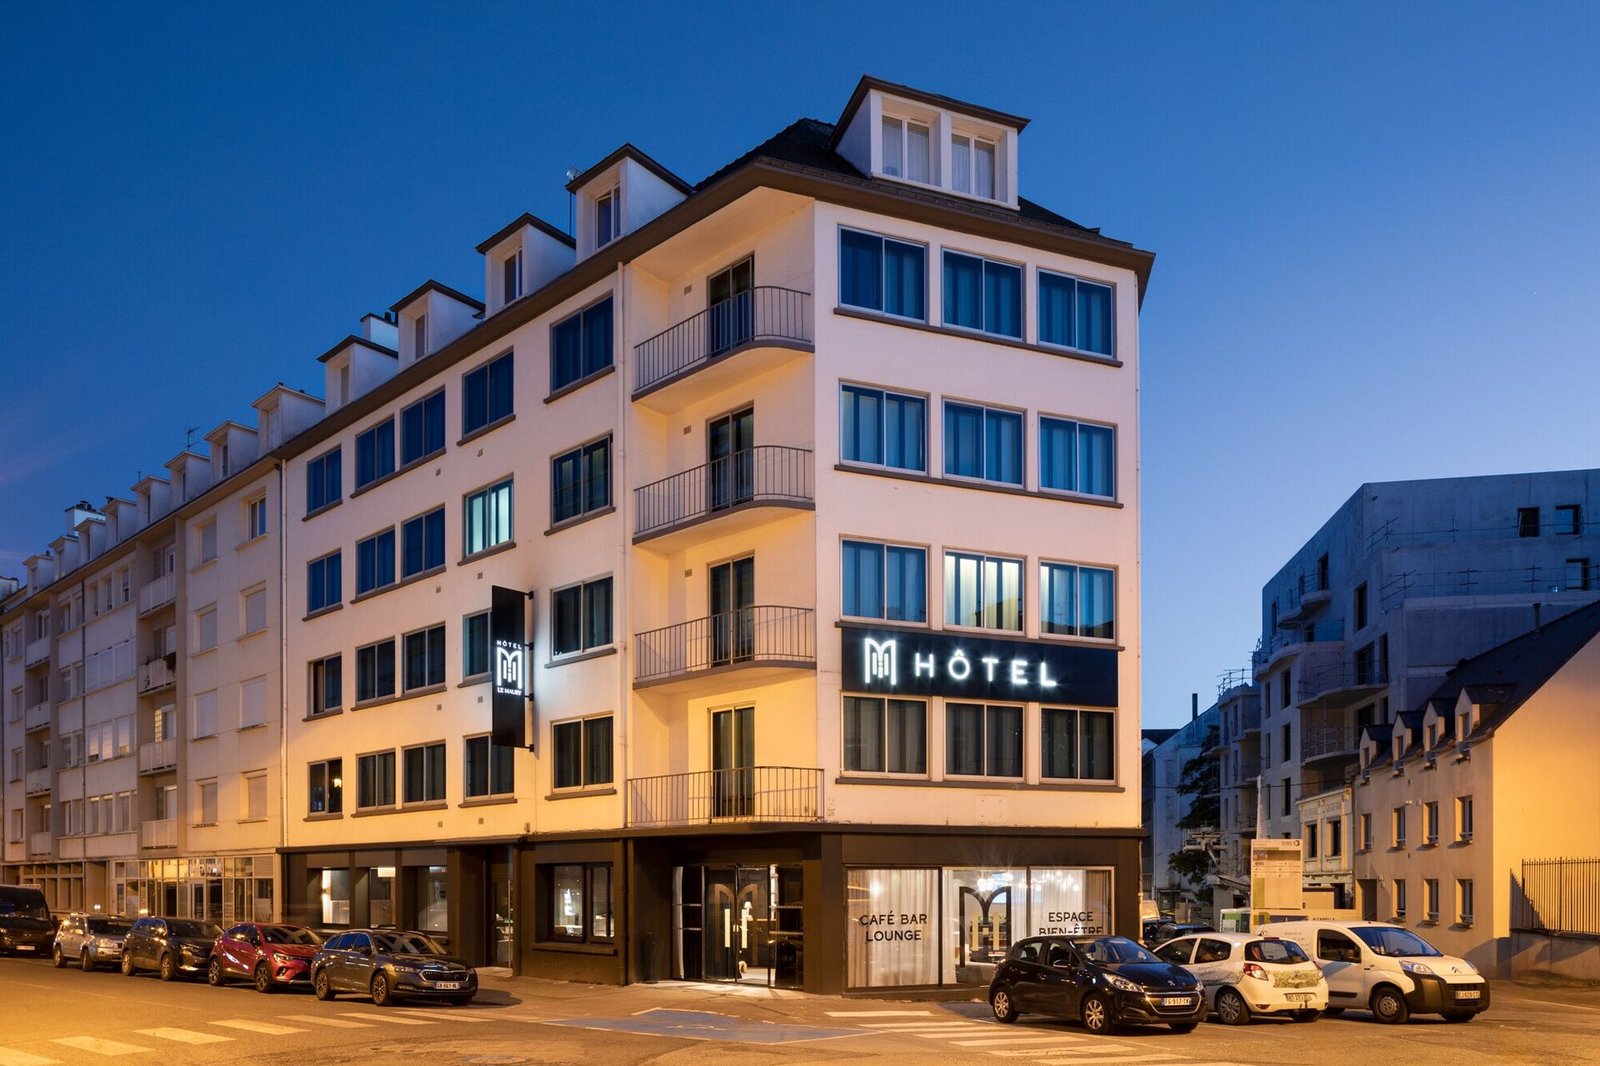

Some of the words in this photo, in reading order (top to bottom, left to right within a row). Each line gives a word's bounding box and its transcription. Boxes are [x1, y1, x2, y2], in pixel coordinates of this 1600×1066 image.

[496, 640, 522, 650] HÔTEL
[914, 648, 1058, 688] HÔTEL
[859, 910, 895, 926] CAFÉ
[900, 913, 928, 925] BAR
[1048, 911, 1094, 923] ESPACE
[865, 929, 922, 942] LOUNGE
